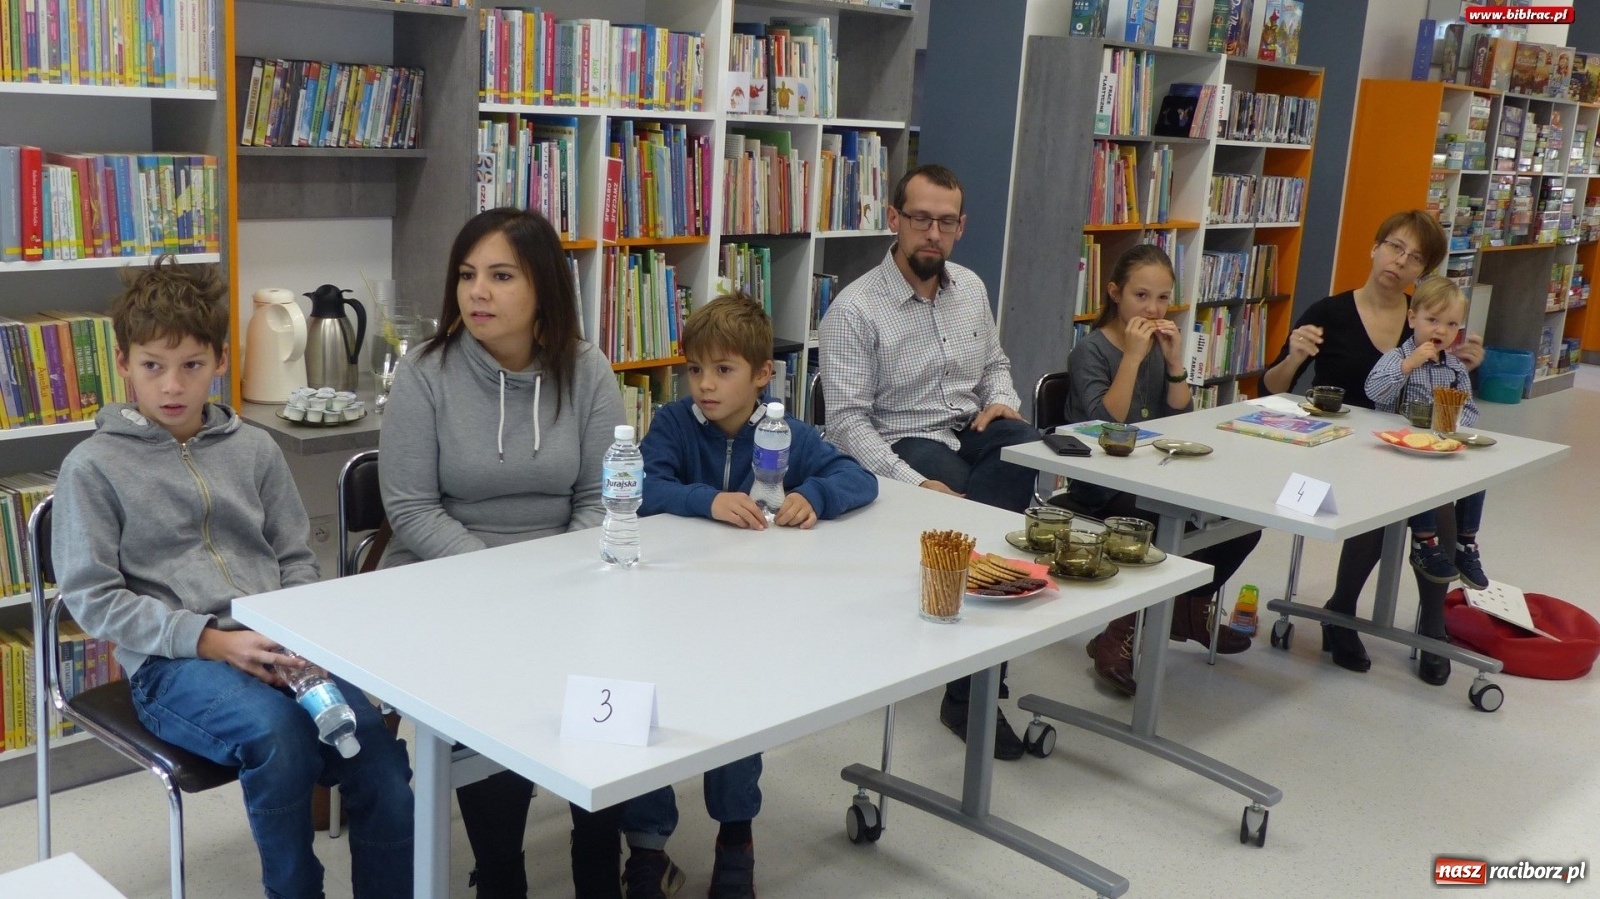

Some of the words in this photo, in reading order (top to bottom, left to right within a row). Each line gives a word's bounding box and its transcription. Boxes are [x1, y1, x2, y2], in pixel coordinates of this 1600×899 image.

[1098, 75, 1108, 114] PLASTYCZNE
[1106, 85, 1114, 105] PRACE
[604, 182, 612, 222] OBYCZAJE
[611, 182, 619, 223] ZWYCZAJE
[37, 366, 49, 398] Amelka
[1189, 356, 1197, 382] ZABAWY
[606, 478, 637, 489] Jurajska
[1296, 480, 1306, 503] 4
[593, 688, 613, 723] 3
